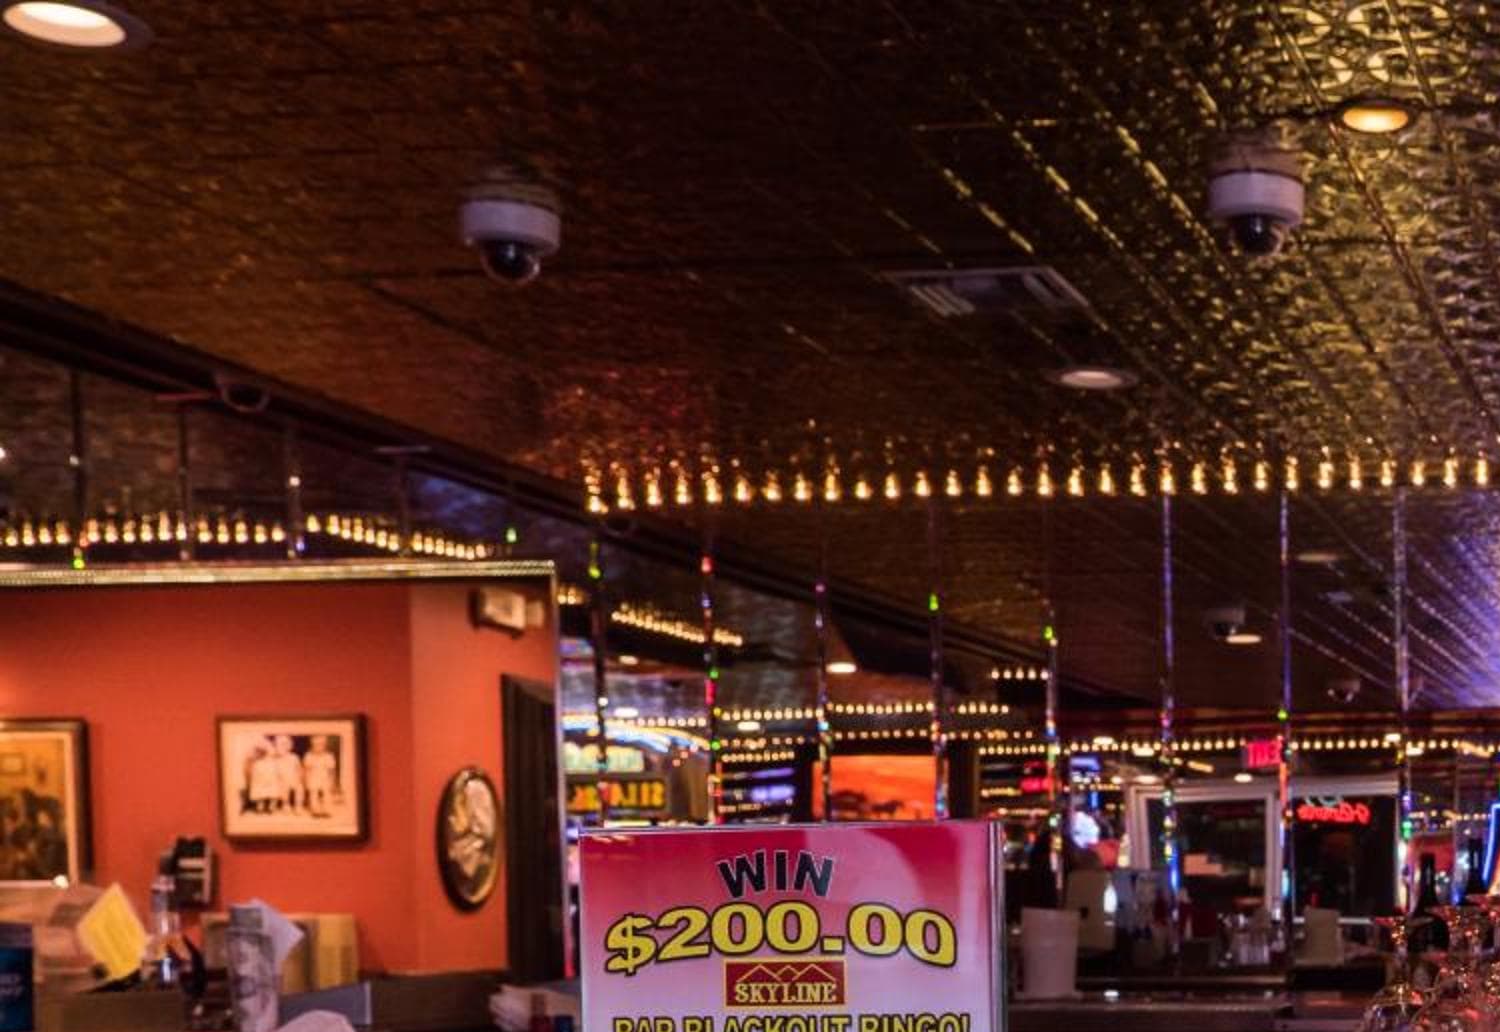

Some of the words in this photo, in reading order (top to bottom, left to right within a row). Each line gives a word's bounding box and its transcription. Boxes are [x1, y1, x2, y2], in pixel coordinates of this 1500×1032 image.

[717, 848, 836, 898] WIN
[604, 901, 958, 976] $200.00
[735, 981, 837, 1004] SKYLINE
